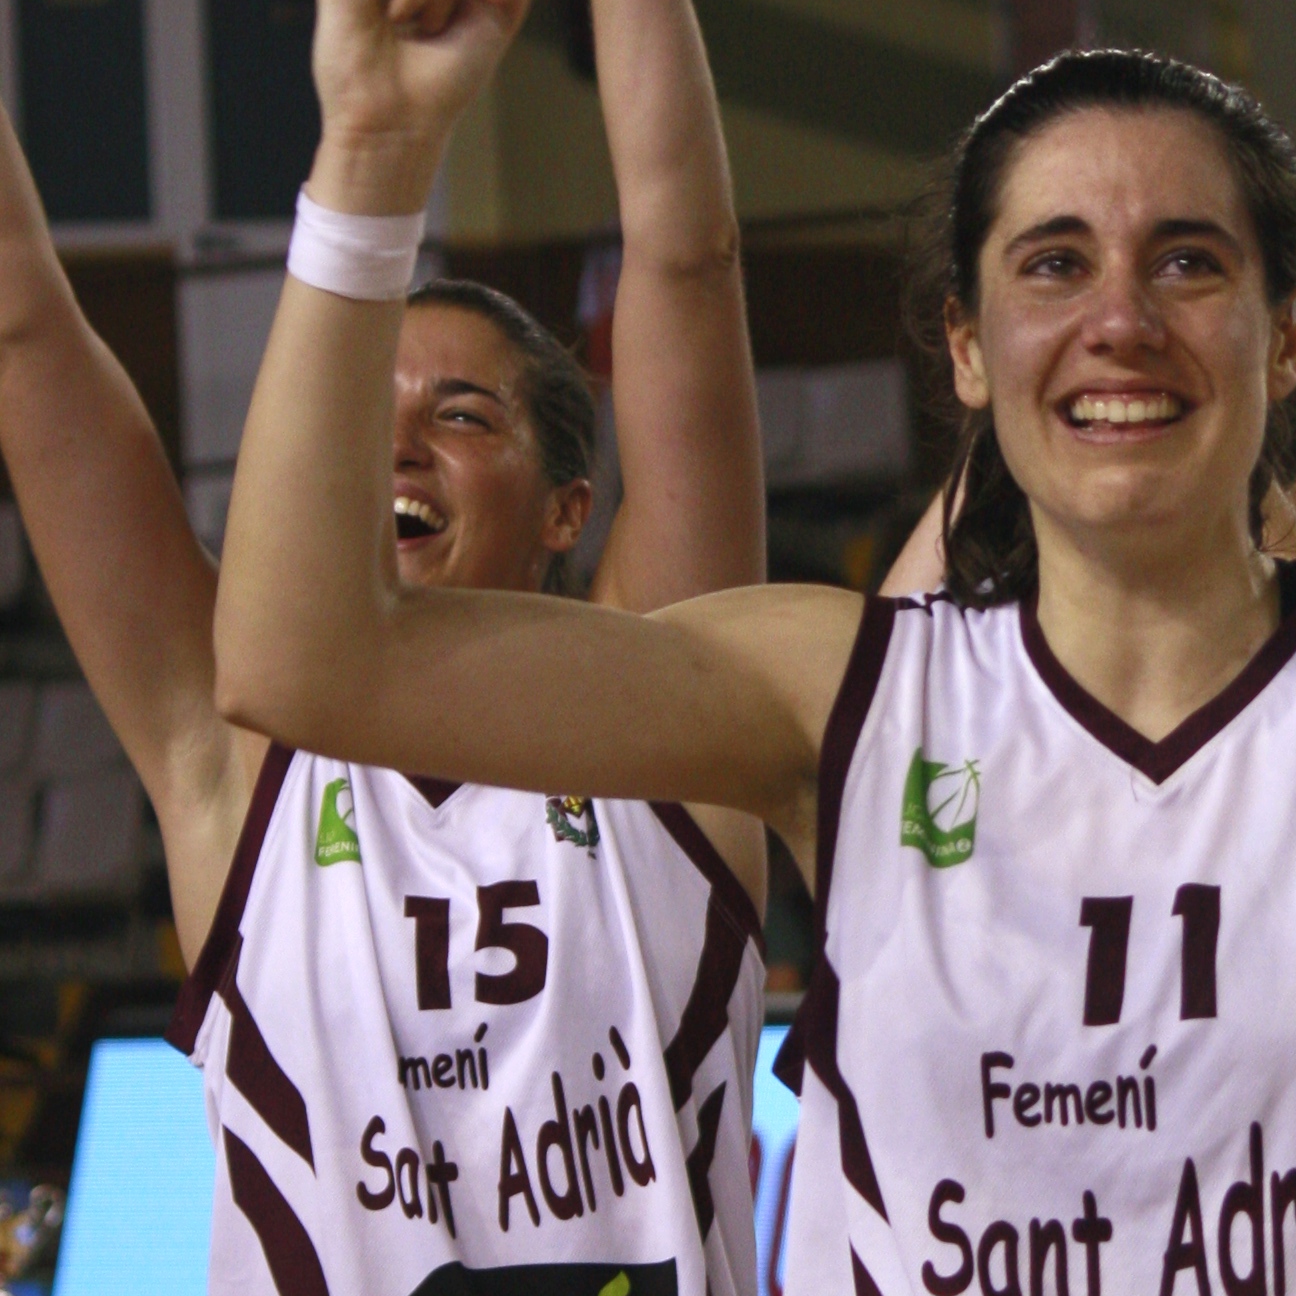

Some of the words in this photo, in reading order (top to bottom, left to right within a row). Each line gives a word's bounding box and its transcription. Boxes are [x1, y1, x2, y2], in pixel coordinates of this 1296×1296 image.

[404, 879, 549, 1011] 15
[1079, 882, 1221, 1027] 11
[399, 1023, 489, 1091] mení
[981, 1044, 1158, 1140] Femení
[498, 1025, 656, 1233] Adrià
